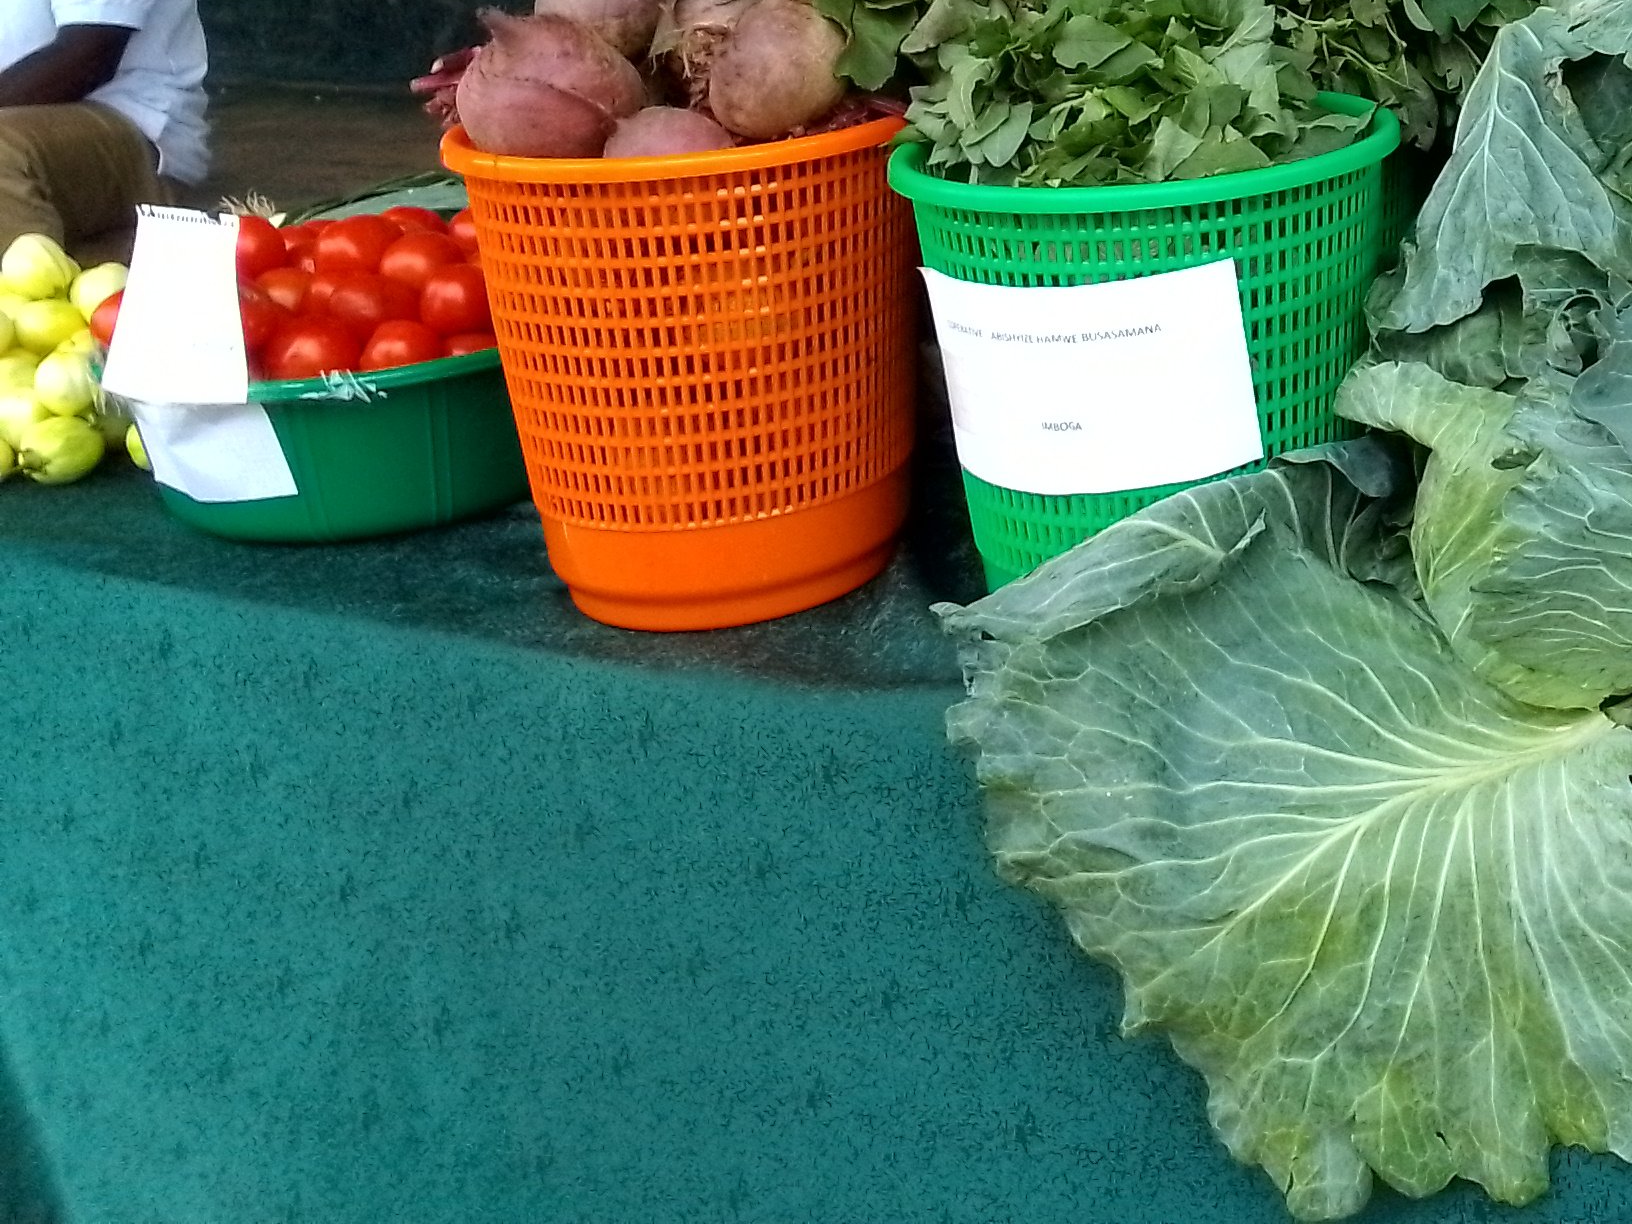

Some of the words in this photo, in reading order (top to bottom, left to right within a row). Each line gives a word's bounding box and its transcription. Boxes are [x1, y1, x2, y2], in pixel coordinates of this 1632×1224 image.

[1036, 334, 1078, 345] HAMWE
[1081, 323, 1162, 343] BUSASAMANA
[1041, 421, 1083, 432] IMBOGA
